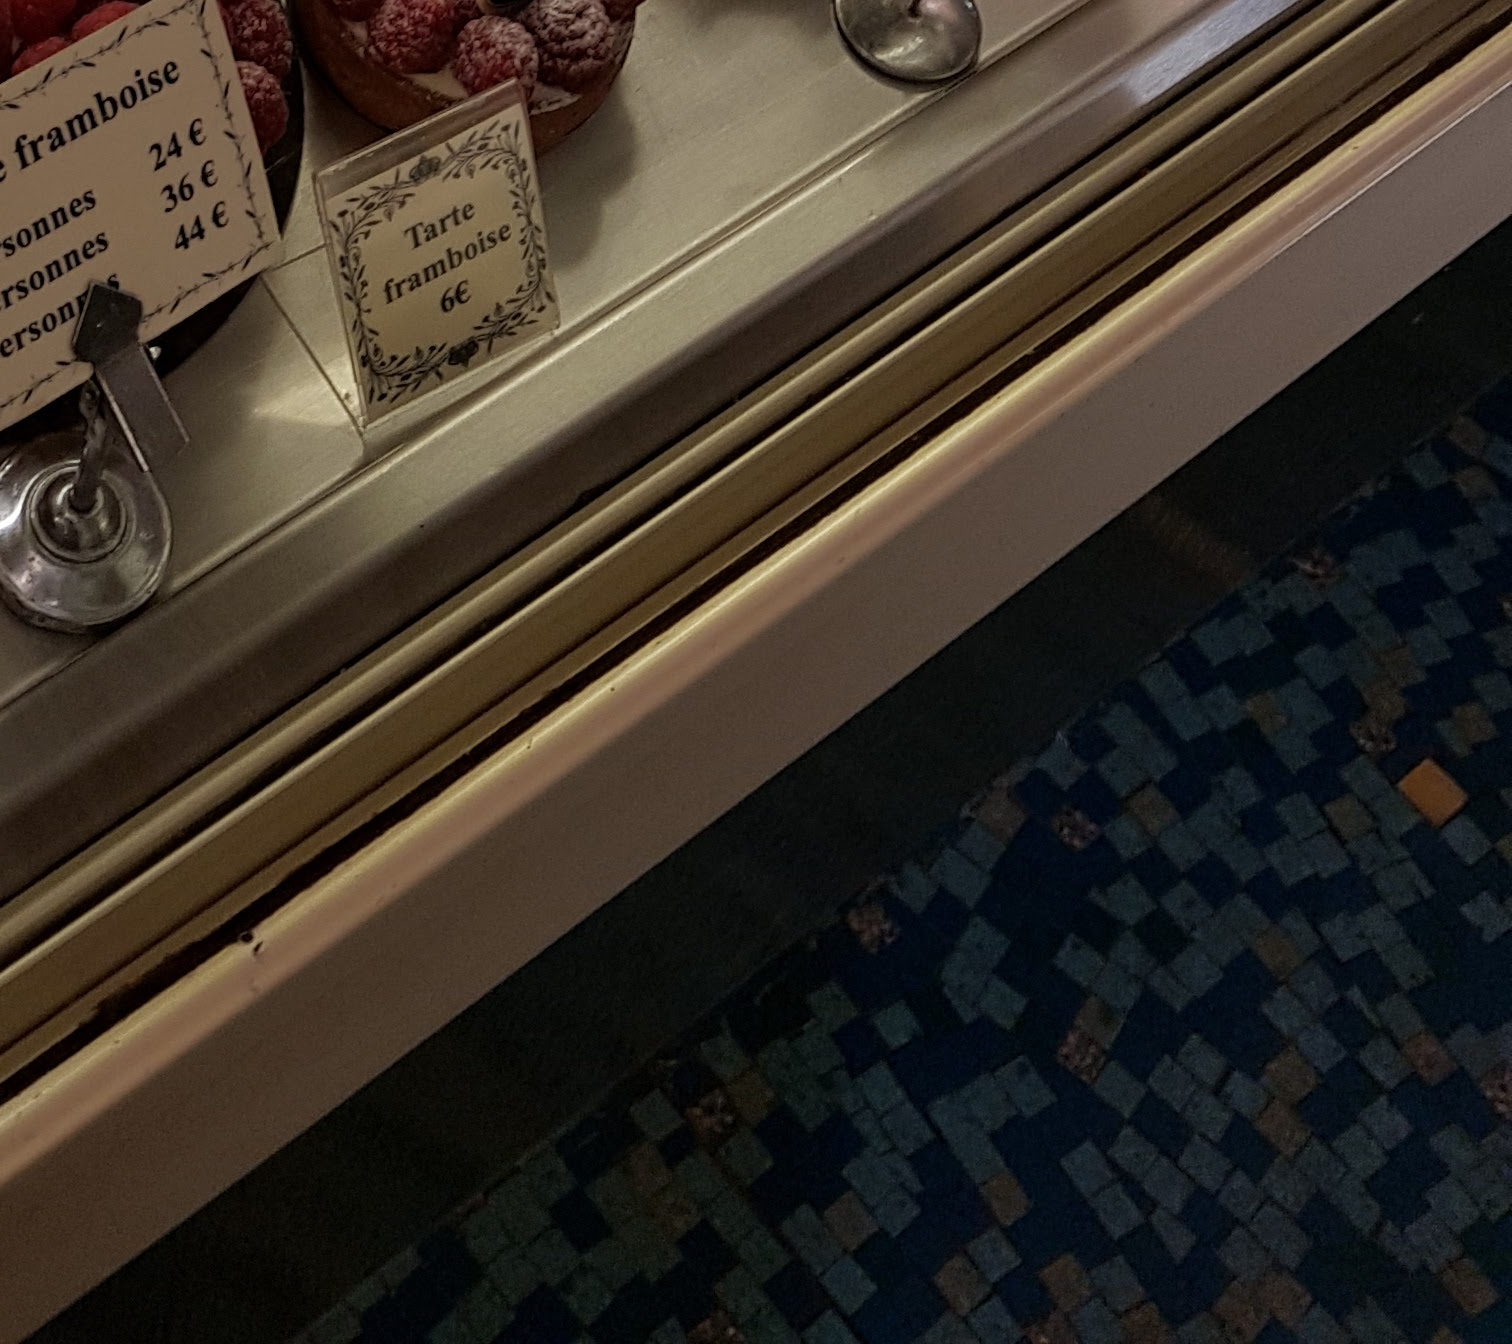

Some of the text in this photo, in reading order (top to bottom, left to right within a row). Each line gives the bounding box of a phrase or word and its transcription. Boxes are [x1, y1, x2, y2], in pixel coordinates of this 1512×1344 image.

[13, 60, 181, 171] framboise
[148, 131, 183, 172] 24
[188, 117, 208, 147] €
[160, 171, 195, 214] 36
[200, 159, 220, 189] €
[174, 214, 206, 251] 44
[212, 200, 230, 229] €
[403, 202, 476, 250] Tarte
[383, 223, 512, 305] framboise
[440, 279, 473, 313] 6€
